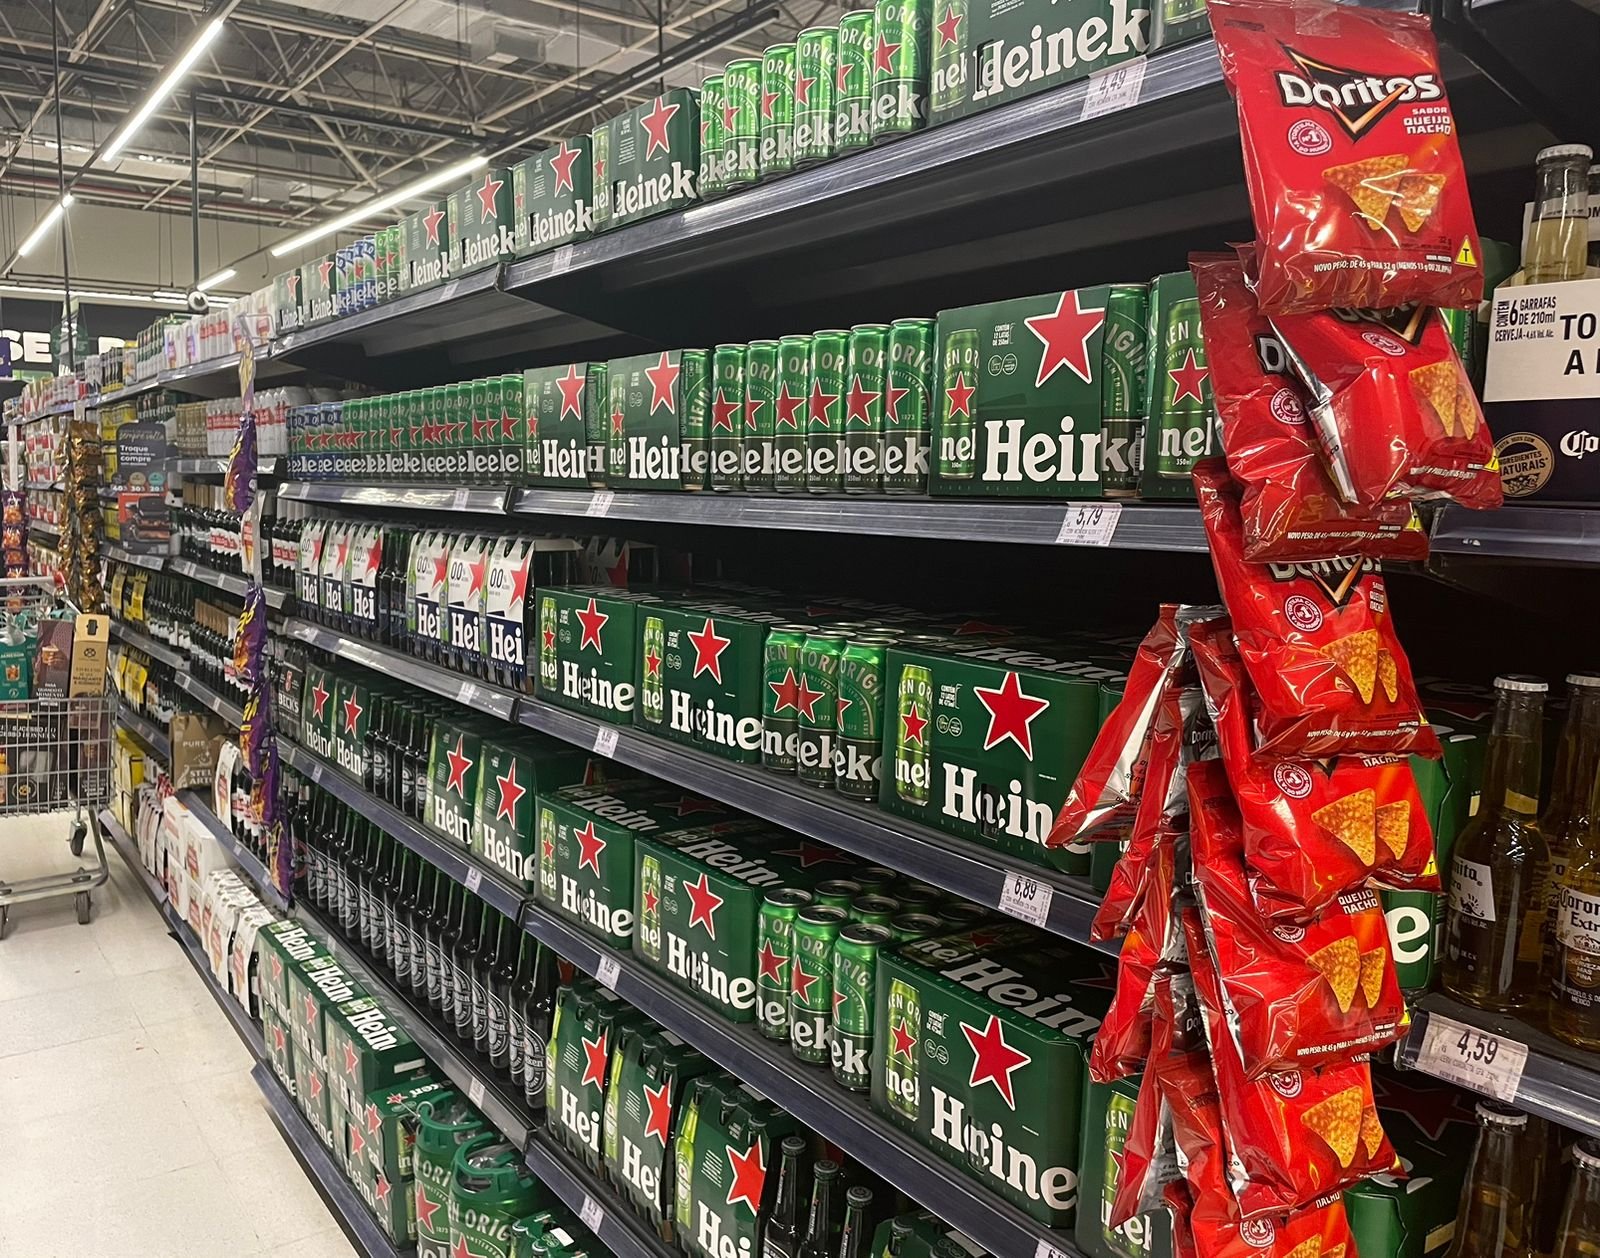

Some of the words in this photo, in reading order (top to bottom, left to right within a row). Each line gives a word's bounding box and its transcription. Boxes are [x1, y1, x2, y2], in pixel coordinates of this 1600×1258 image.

[1279, 73, 1442, 109] Doritos
[1403, 115, 1451, 126] QUEIJO
[1412, 106, 1448, 115] SABOR
[1406, 126, 1452, 135] NACHO
[1509, 299, 1518, 326] 6
[1520, 296, 1557, 311] GARRAFAS
[1518, 313, 1529, 326] DE
[1531, 311, 1556, 324] 210ml
[1564, 350, 1585, 375] A
[120, 445, 149, 453] Troque
[1076, 508, 1104, 530] 5,79
[490, 622, 524, 666] Hei
[1014, 878, 1037, 901] 6,89
[1338, 889, 1374, 907] QUEIJO
[1343, 897, 1379, 914] NACHO
[1457, 1028, 1498, 1065] 4,59
[559, 1085, 600, 1152] Hei
